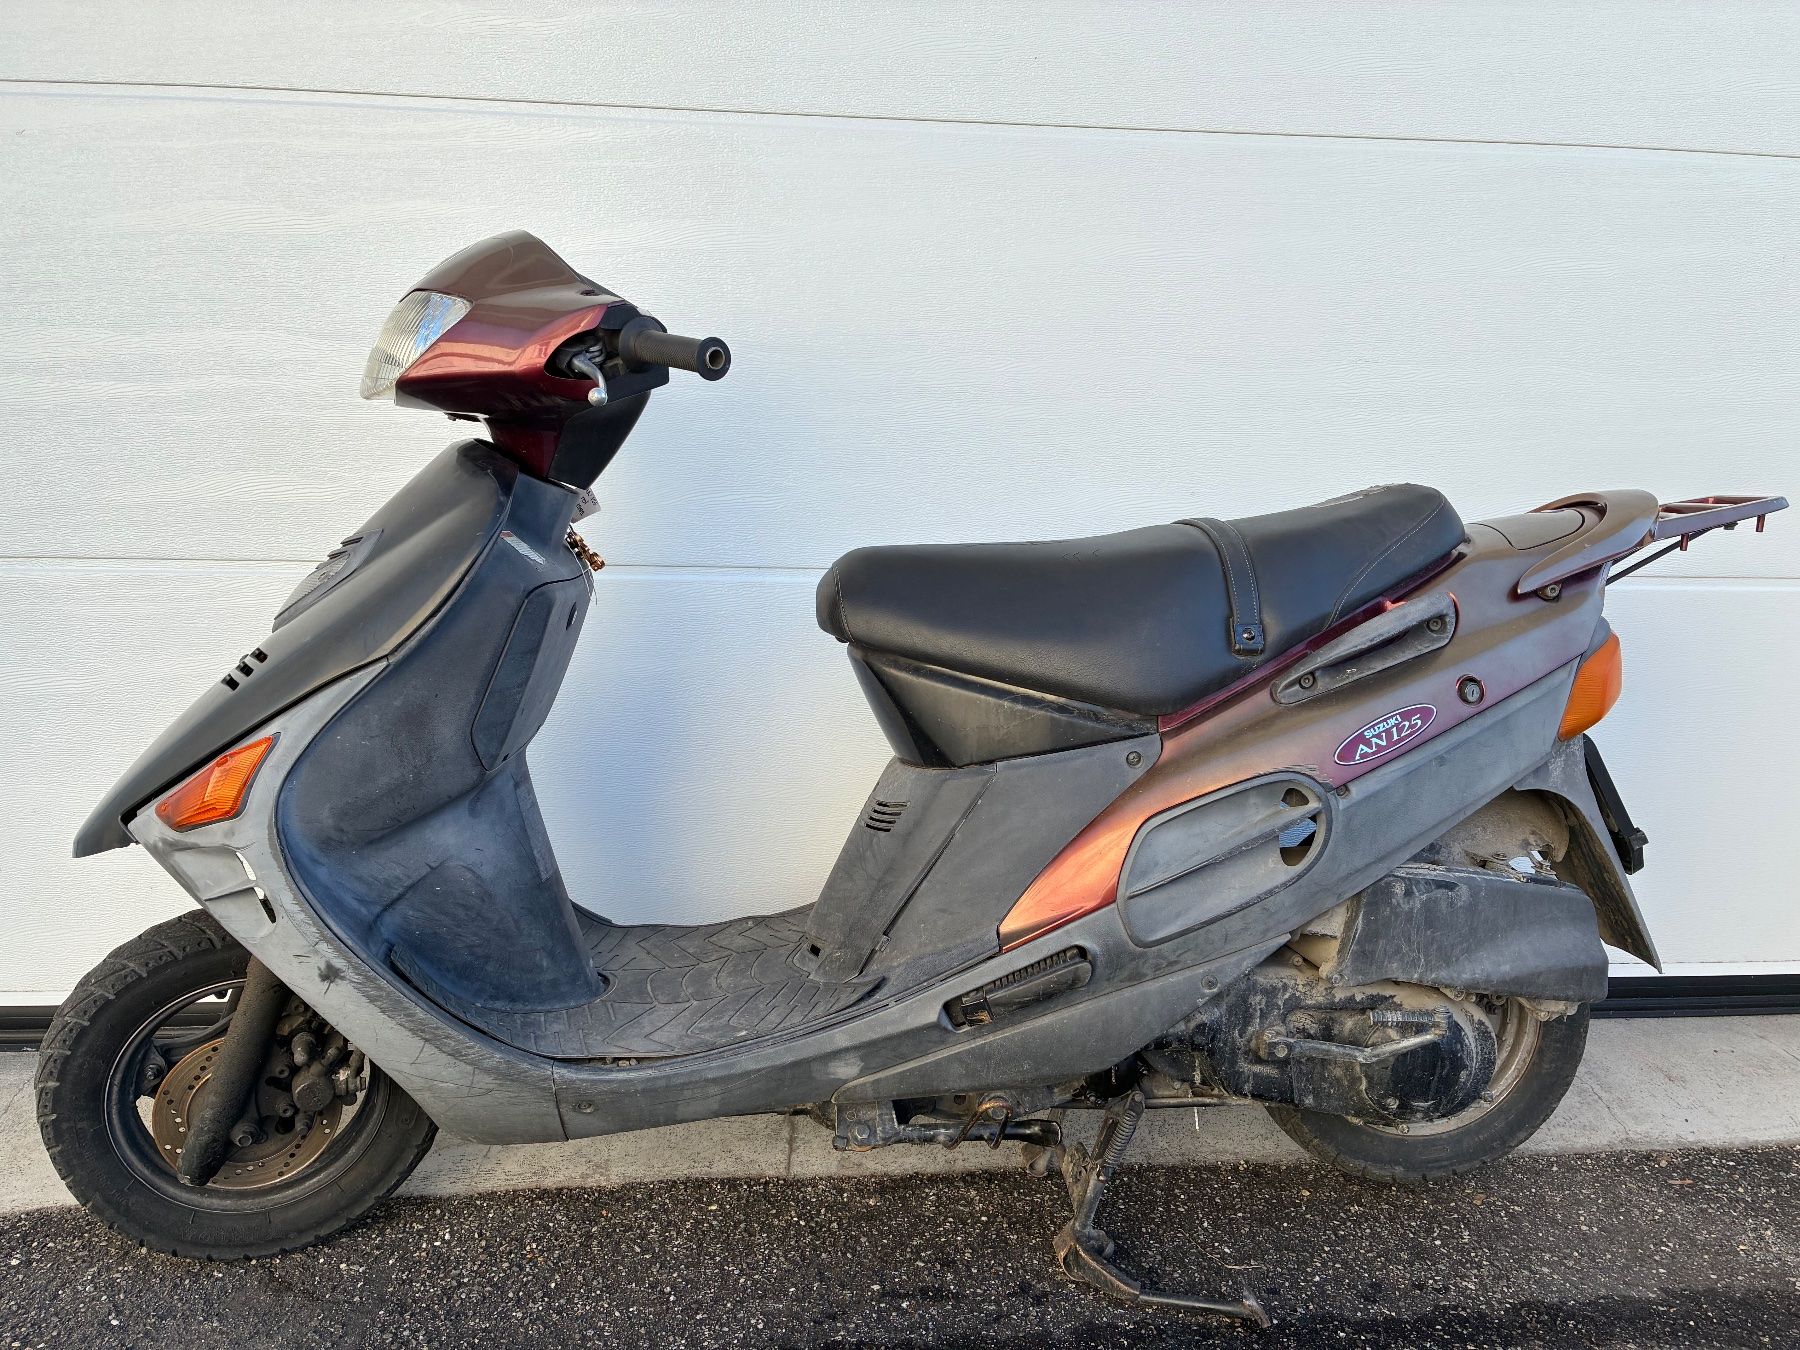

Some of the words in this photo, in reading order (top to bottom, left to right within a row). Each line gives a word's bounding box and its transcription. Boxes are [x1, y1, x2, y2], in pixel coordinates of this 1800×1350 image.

[1356, 733, 1387, 760] AN
[1391, 714, 1422, 741] 125
[1364, 715, 1402, 738] SUZUKI
